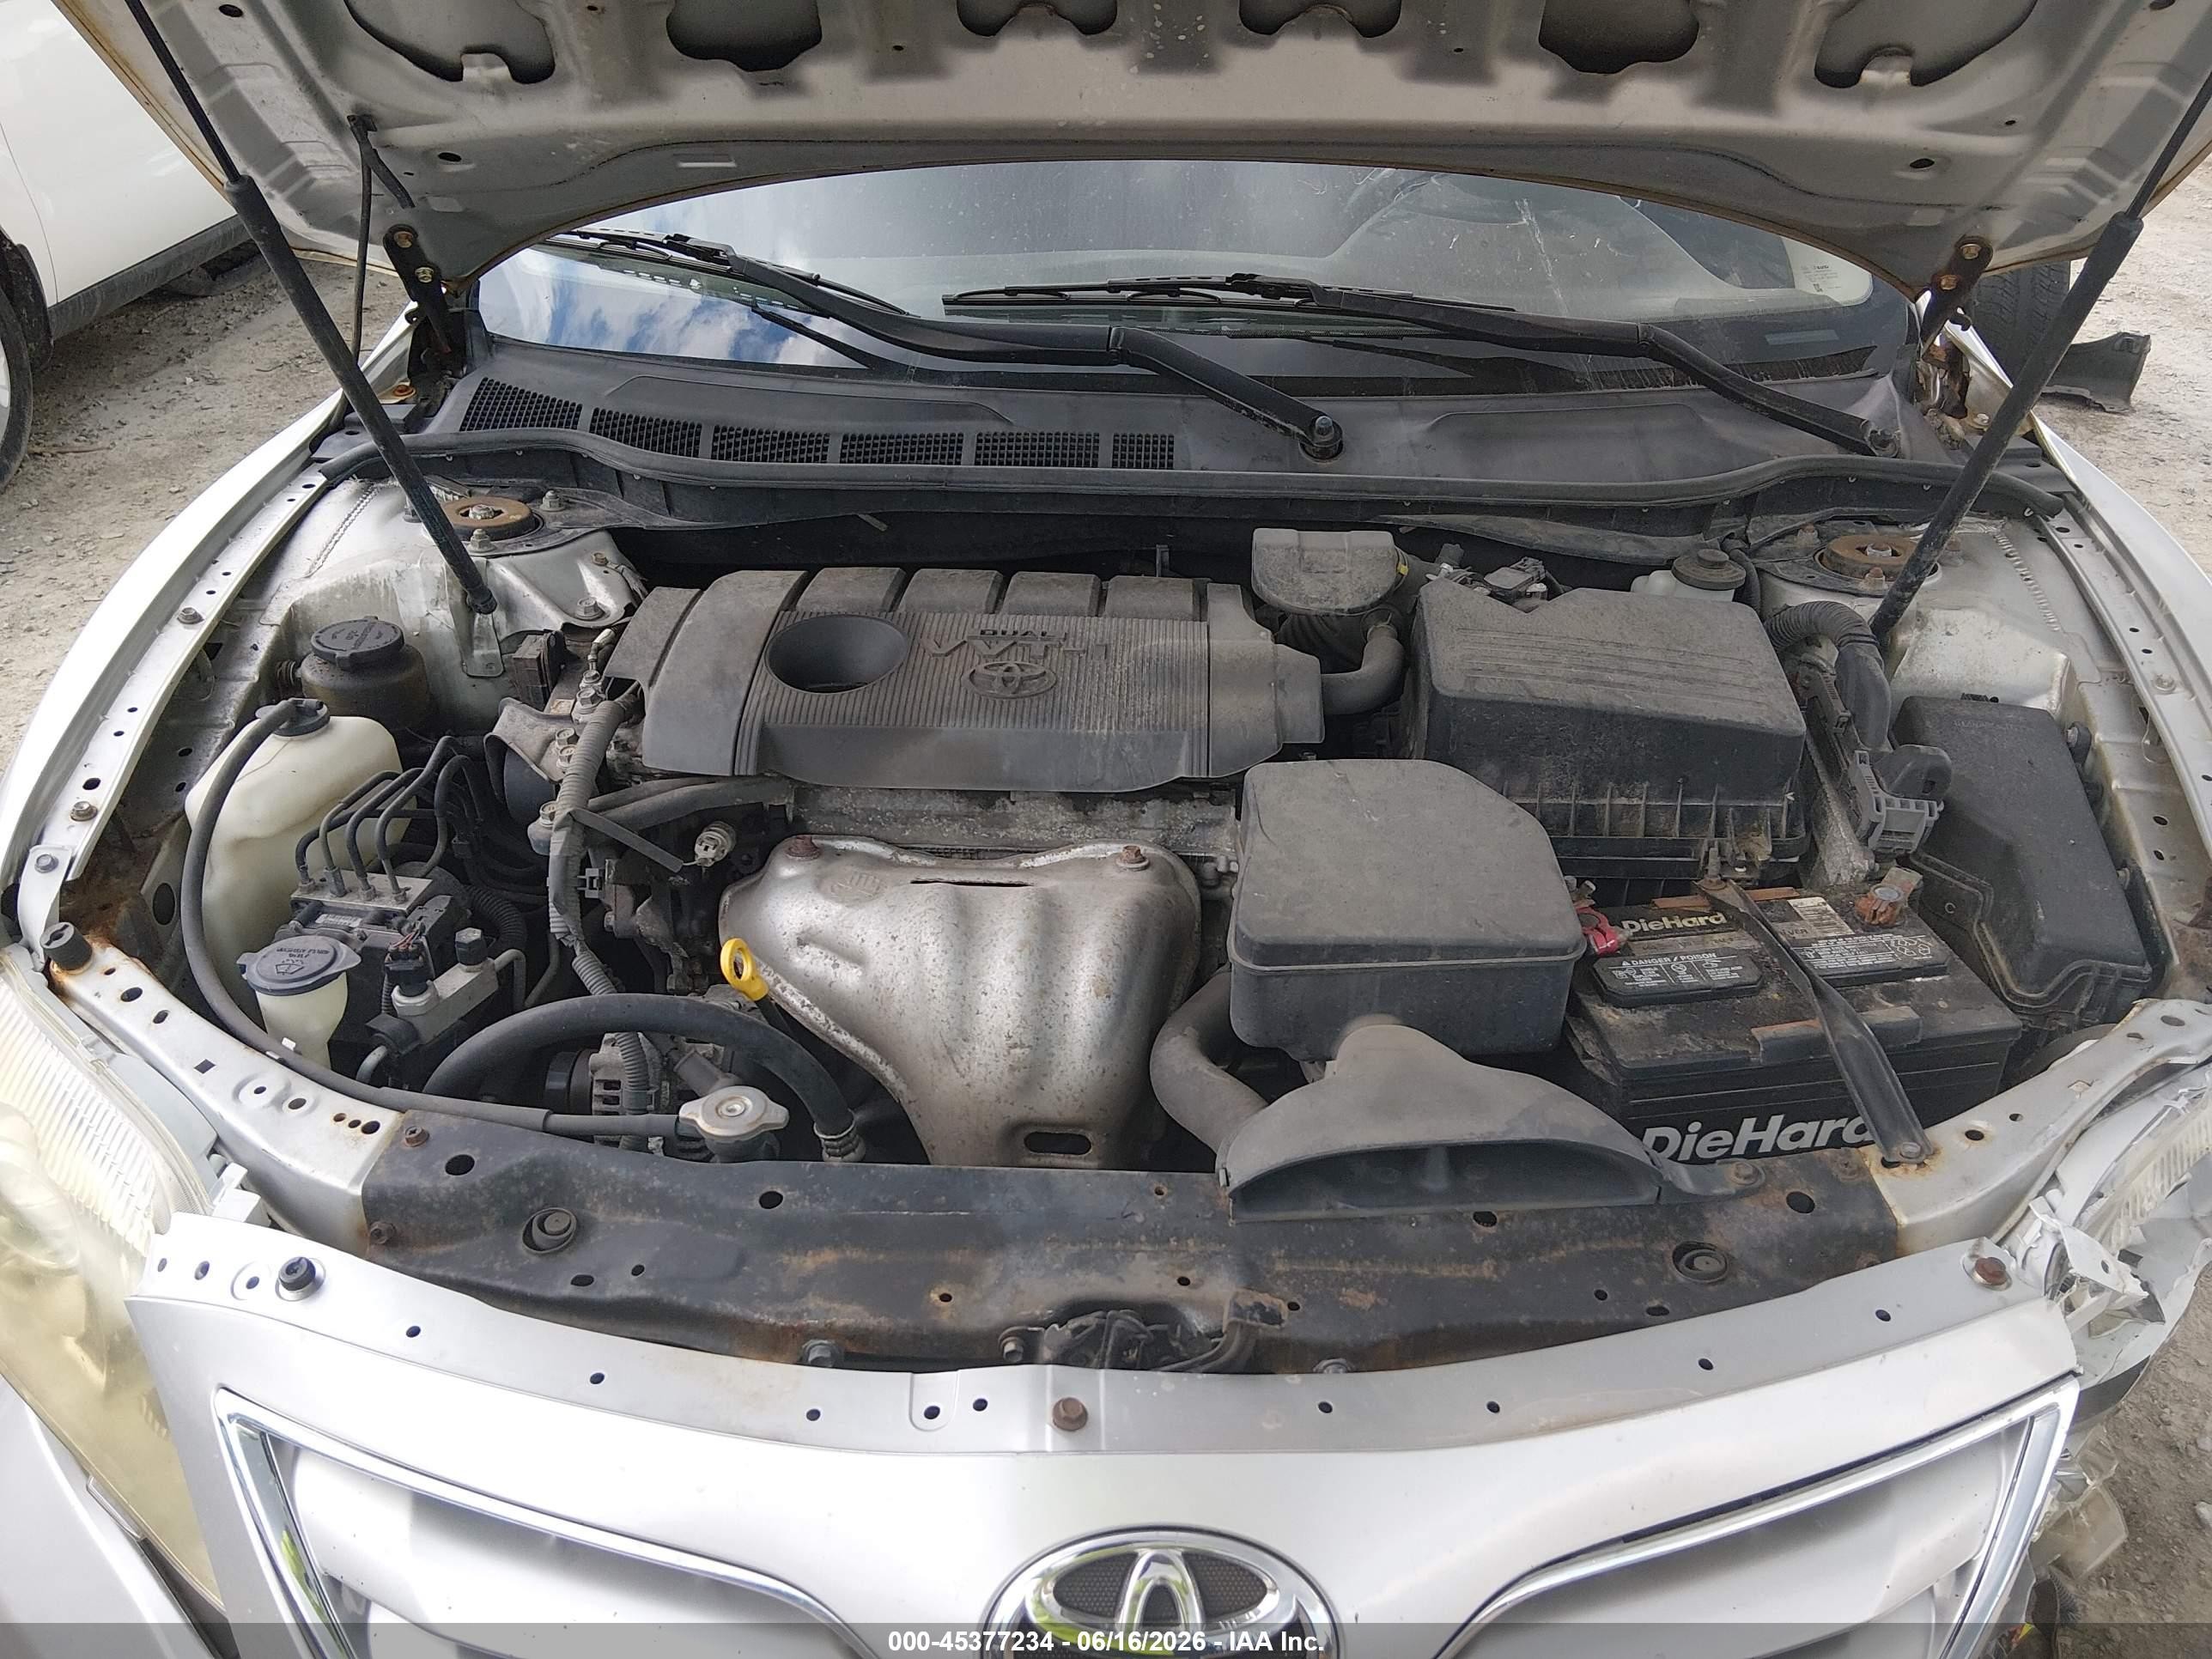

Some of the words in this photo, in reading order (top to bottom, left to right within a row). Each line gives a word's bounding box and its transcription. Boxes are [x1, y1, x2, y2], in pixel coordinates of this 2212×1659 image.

[979, 629, 1057, 638] DUAL
[1621, 912, 1728, 933] DieHard
[1631, 957, 1672, 967] DANGER
[1679, 951, 1717, 963] POISON
